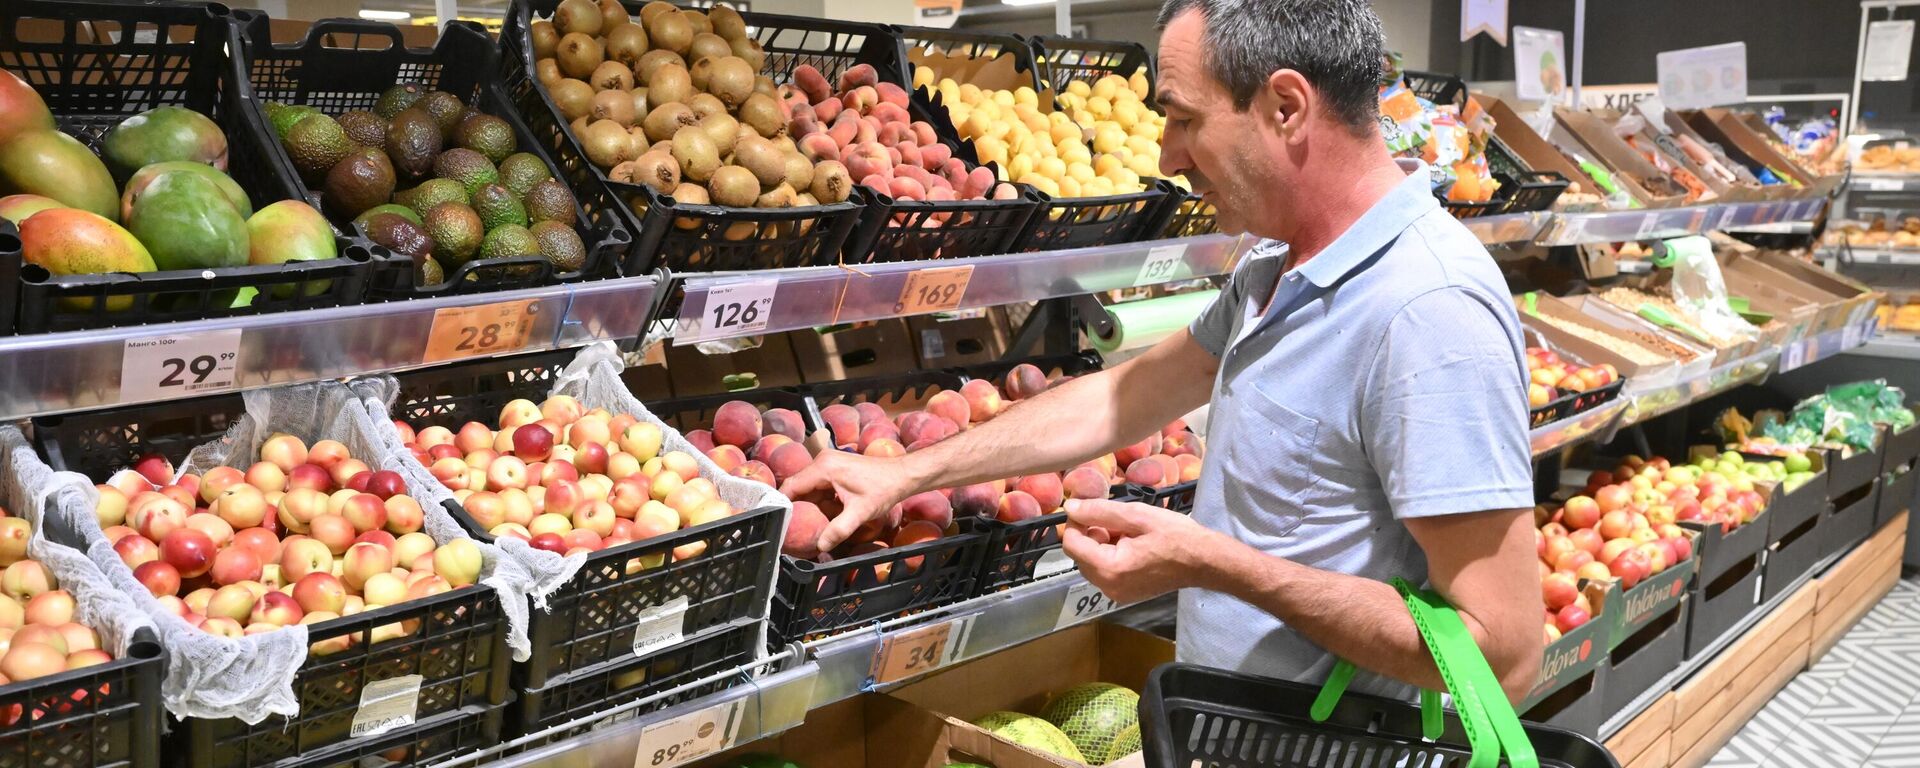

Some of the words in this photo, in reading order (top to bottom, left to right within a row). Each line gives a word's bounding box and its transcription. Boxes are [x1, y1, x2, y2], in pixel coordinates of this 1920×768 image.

[1145, 259, 1173, 278] 139
[917, 284, 957, 306] 169
[713, 300, 759, 328] 126
[455, 324, 501, 351] 28
[159, 355, 217, 387] 29
[220, 352, 236, 360] 99
[1075, 592, 1103, 616] 99
[1624, 583, 1671, 624] Moldova
[905, 642, 937, 669] 34
[651, 743, 681, 766] 89
[682, 739, 694, 747] 99
